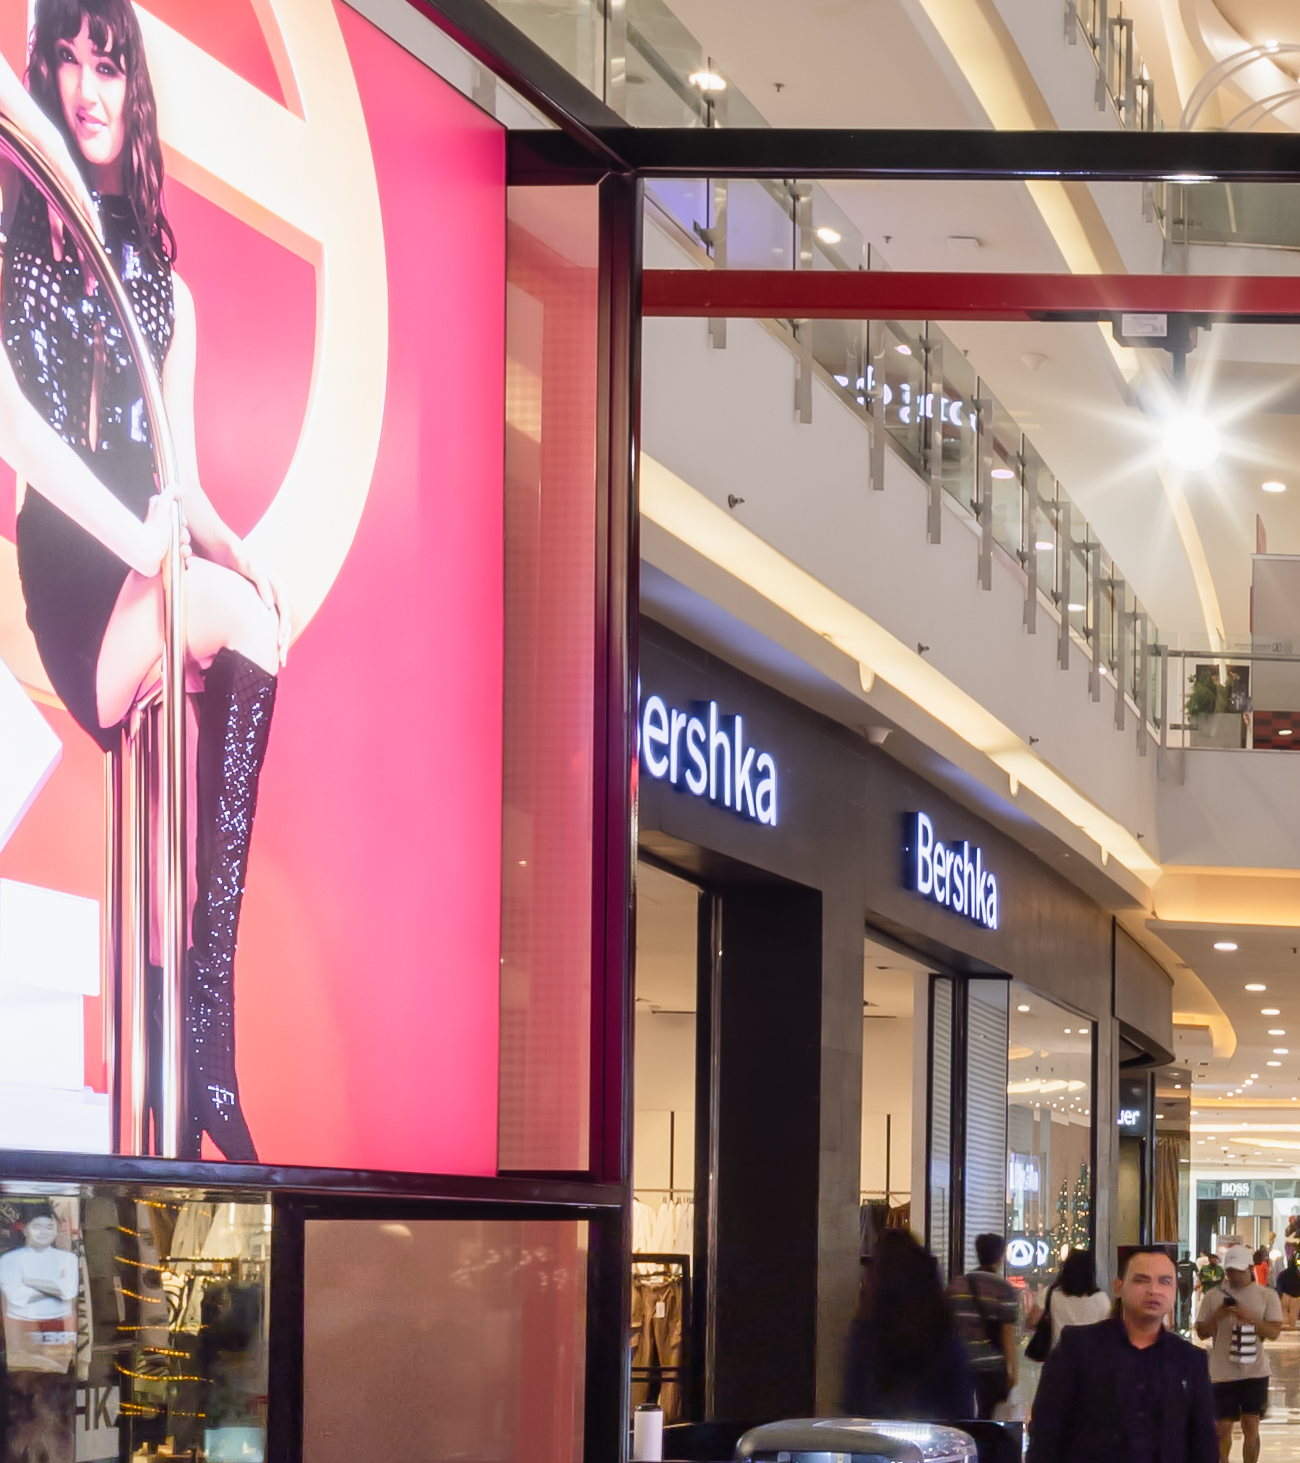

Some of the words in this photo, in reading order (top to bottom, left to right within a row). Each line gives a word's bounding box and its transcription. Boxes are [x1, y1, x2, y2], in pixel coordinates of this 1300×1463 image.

[638, 688, 777, 827] ershka
[917, 811, 998, 931] Bershka
[1222, 1182, 1250, 1196] BOSS
